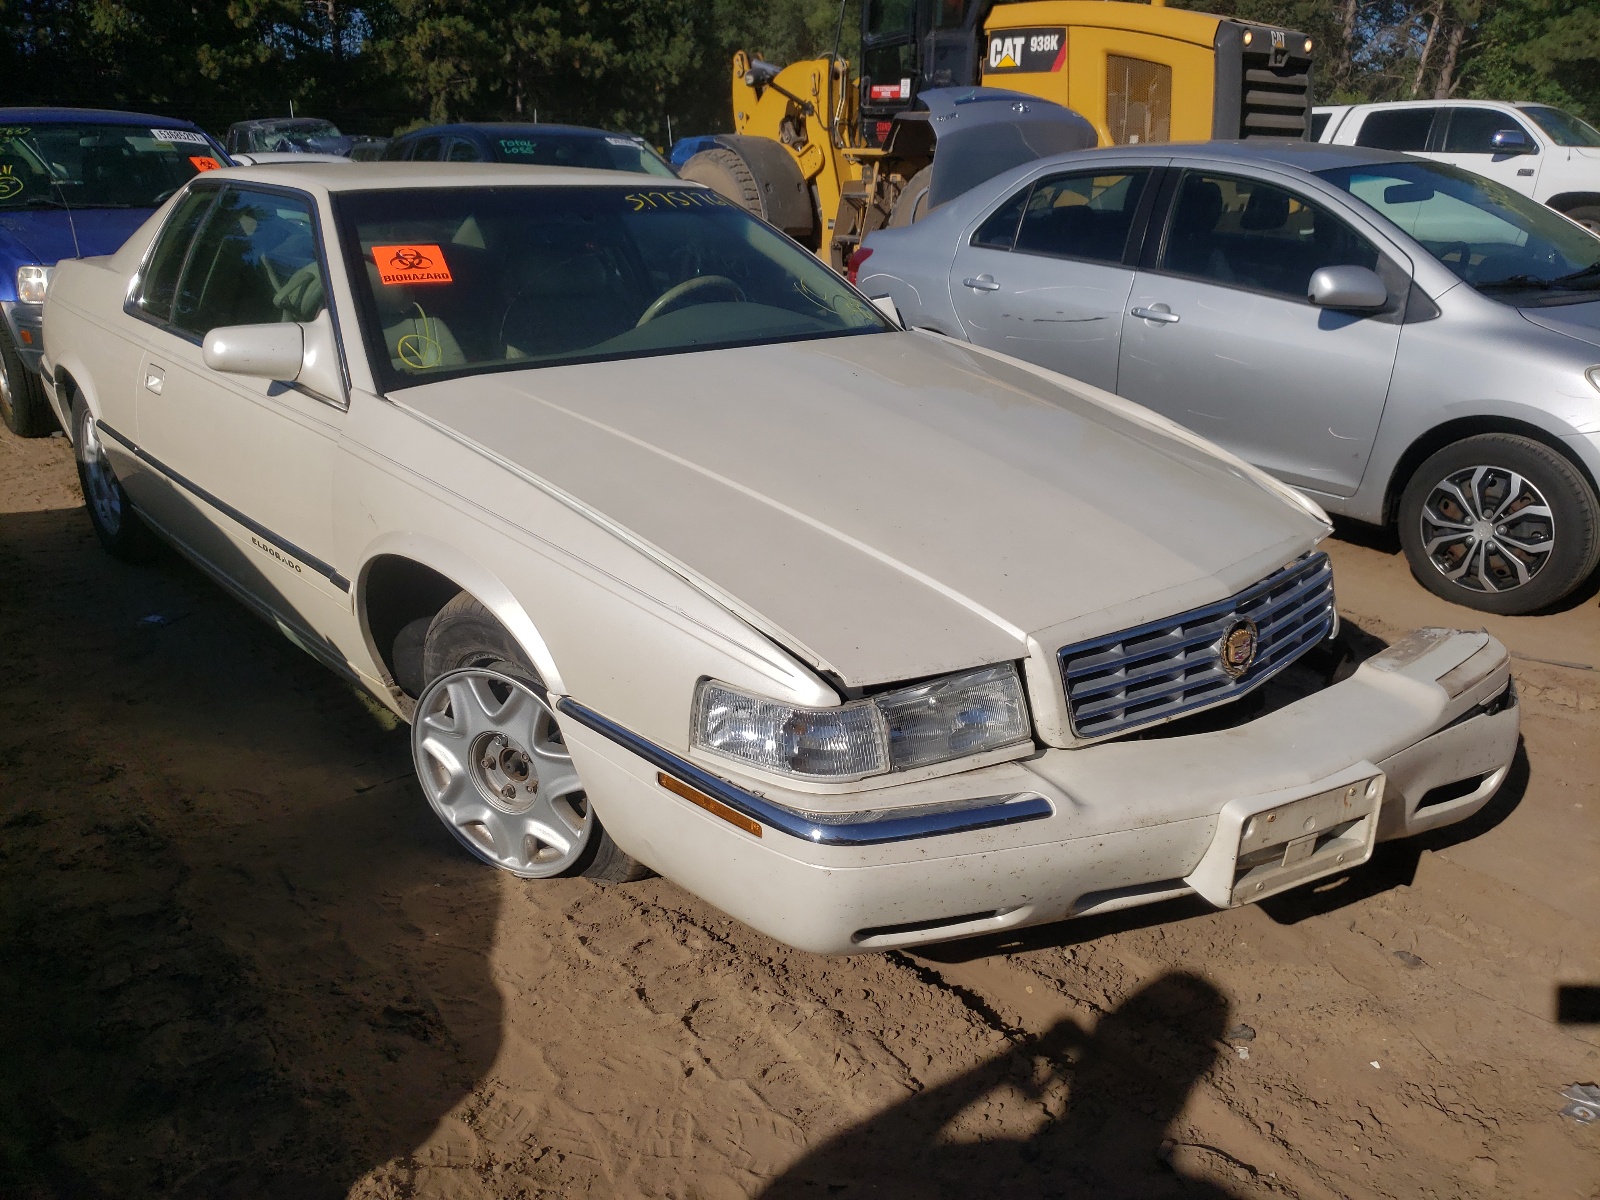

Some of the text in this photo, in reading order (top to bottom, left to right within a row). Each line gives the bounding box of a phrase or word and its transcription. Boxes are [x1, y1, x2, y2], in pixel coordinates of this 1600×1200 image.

[989, 34, 1059, 68] CAT 938K
[1270, 30, 1285, 48] CAT
[383, 272, 449, 282] BIOHAZARD
[251, 536, 302, 573] ELDORADO
